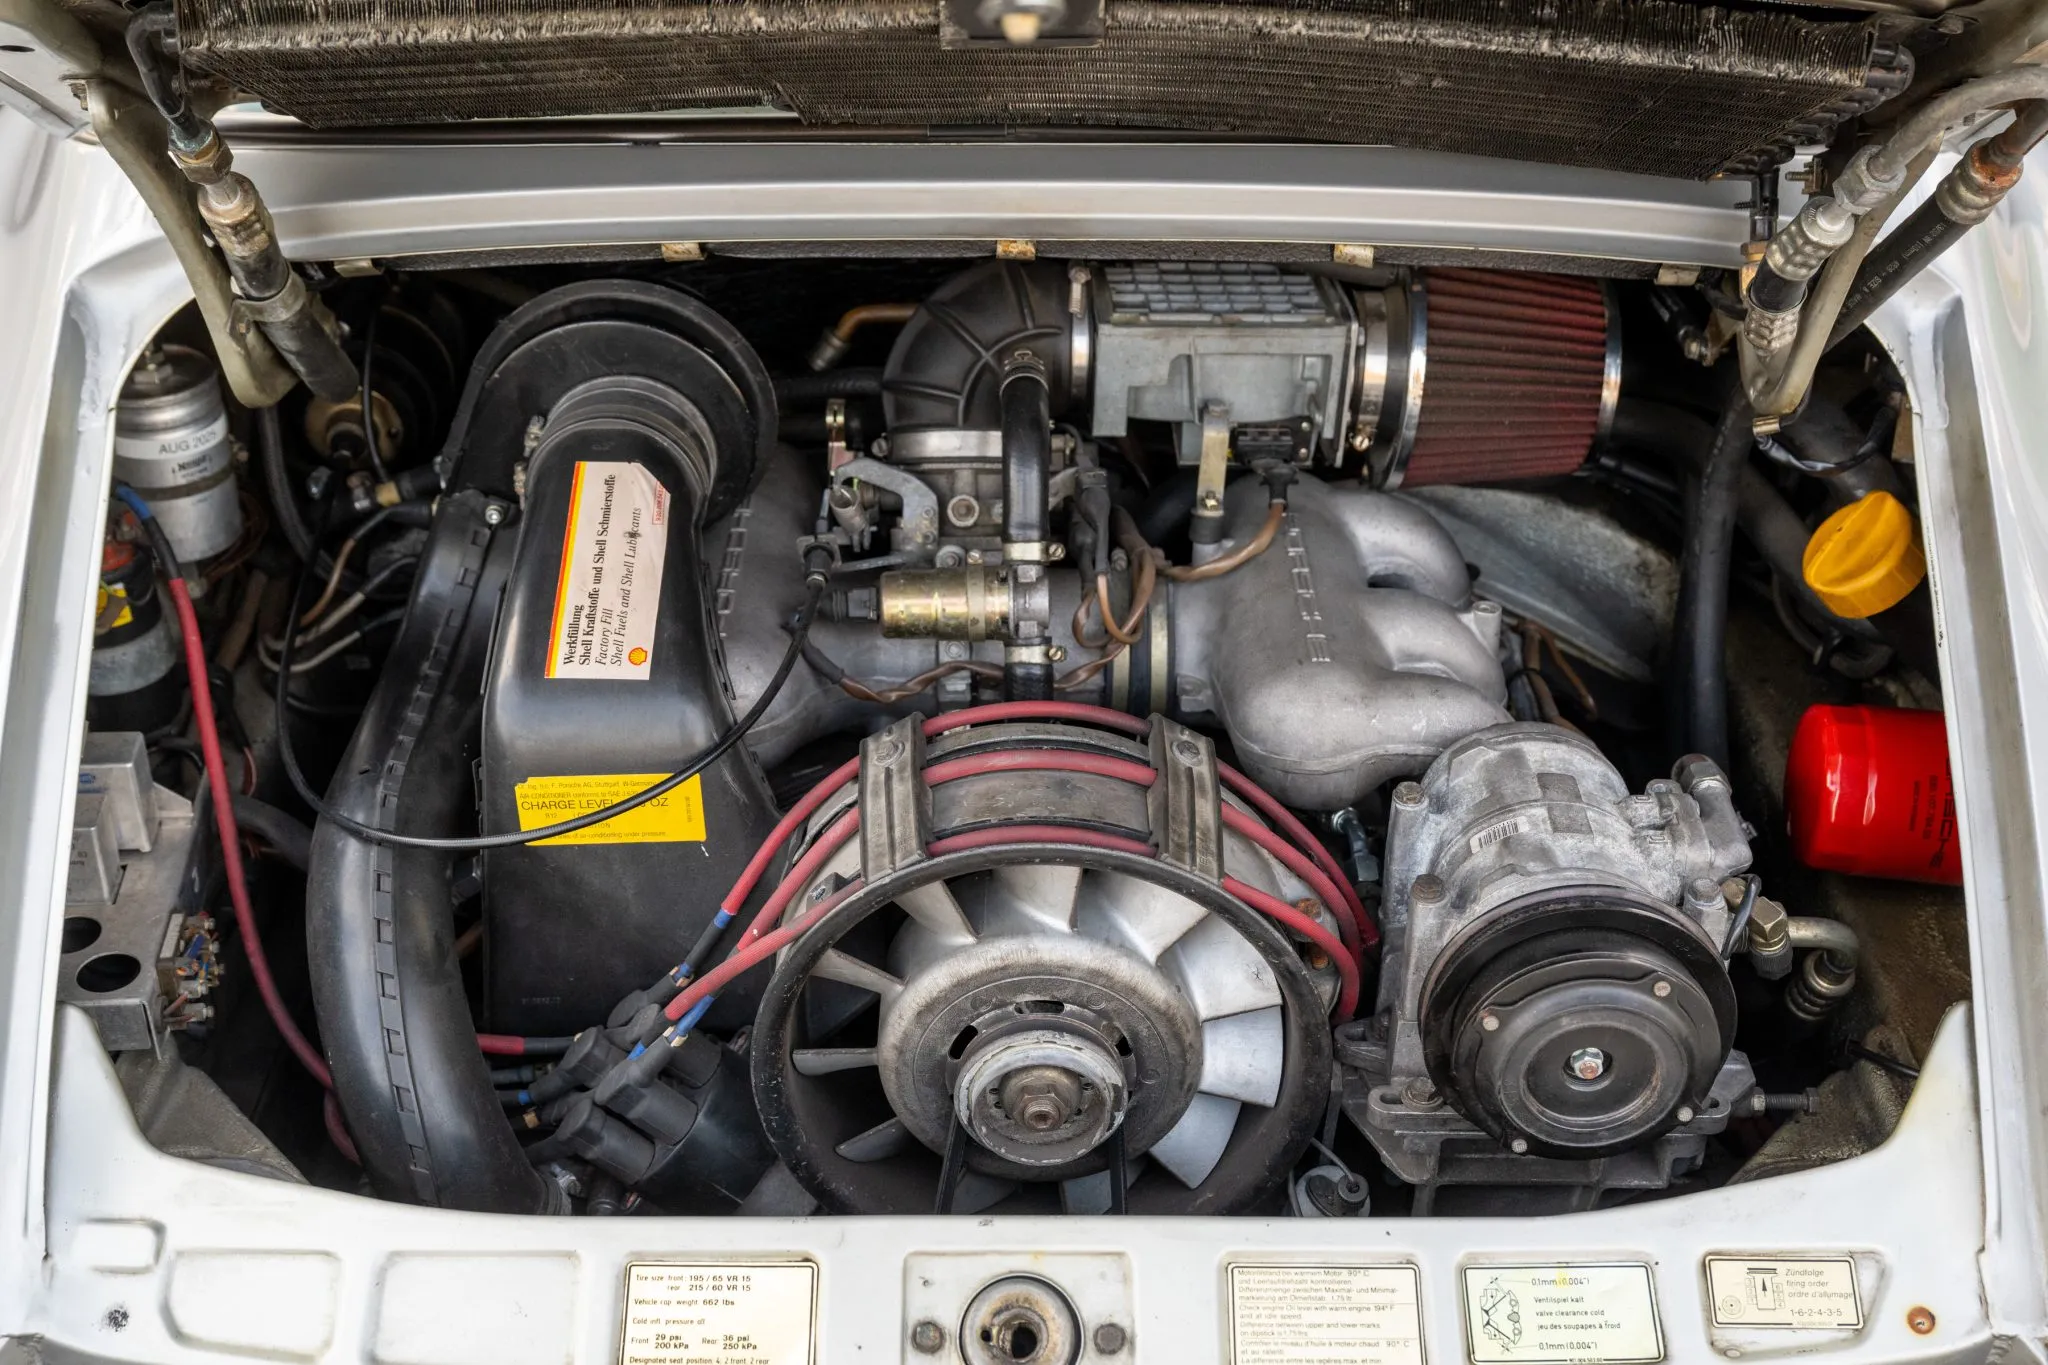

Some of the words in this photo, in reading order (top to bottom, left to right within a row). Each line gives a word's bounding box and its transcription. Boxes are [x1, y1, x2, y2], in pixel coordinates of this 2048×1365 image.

[159, 441, 189, 454] AUG
[597, 474, 616, 537] Schmierstoffe
[625, 507, 642, 559] Lubcants
[593, 539, 607, 564] Shell
[593, 566, 603, 584] und
[621, 560, 635, 586] Shell
[620, 588, 630, 608] and
[583, 587, 600, 635] Kraftstoffe
[601, 608, 613, 626] Fill
[615, 607, 628, 636] Fuels
[563, 604, 585, 666] Werkfüllung
[579, 637, 593, 666] Shell
[595, 627, 613, 666] Factory
[611, 638, 625, 666] Shell
[521, 800, 577, 810] CHARGE
[650, 797, 669, 807] OZ
[1786, 1280, 1806, 1288] firing
[1533, 1296, 1569, 1304] Ventilspiel
[1789, 1308, 1843, 1317] 1-6-2-4-3-5
[1537, 1323, 1549, 1331] jeu
[1563, 1323, 1597, 1331] soupapes
[1604, 1321, 1621, 1329] froid
[631, 1336, 649, 1344] Front
[673, 1342, 689, 1350] kPa
[722, 1334, 734, 1342] 36
[629, 1356, 667, 1365] Designated
[686, 1357, 713, 1365] position
